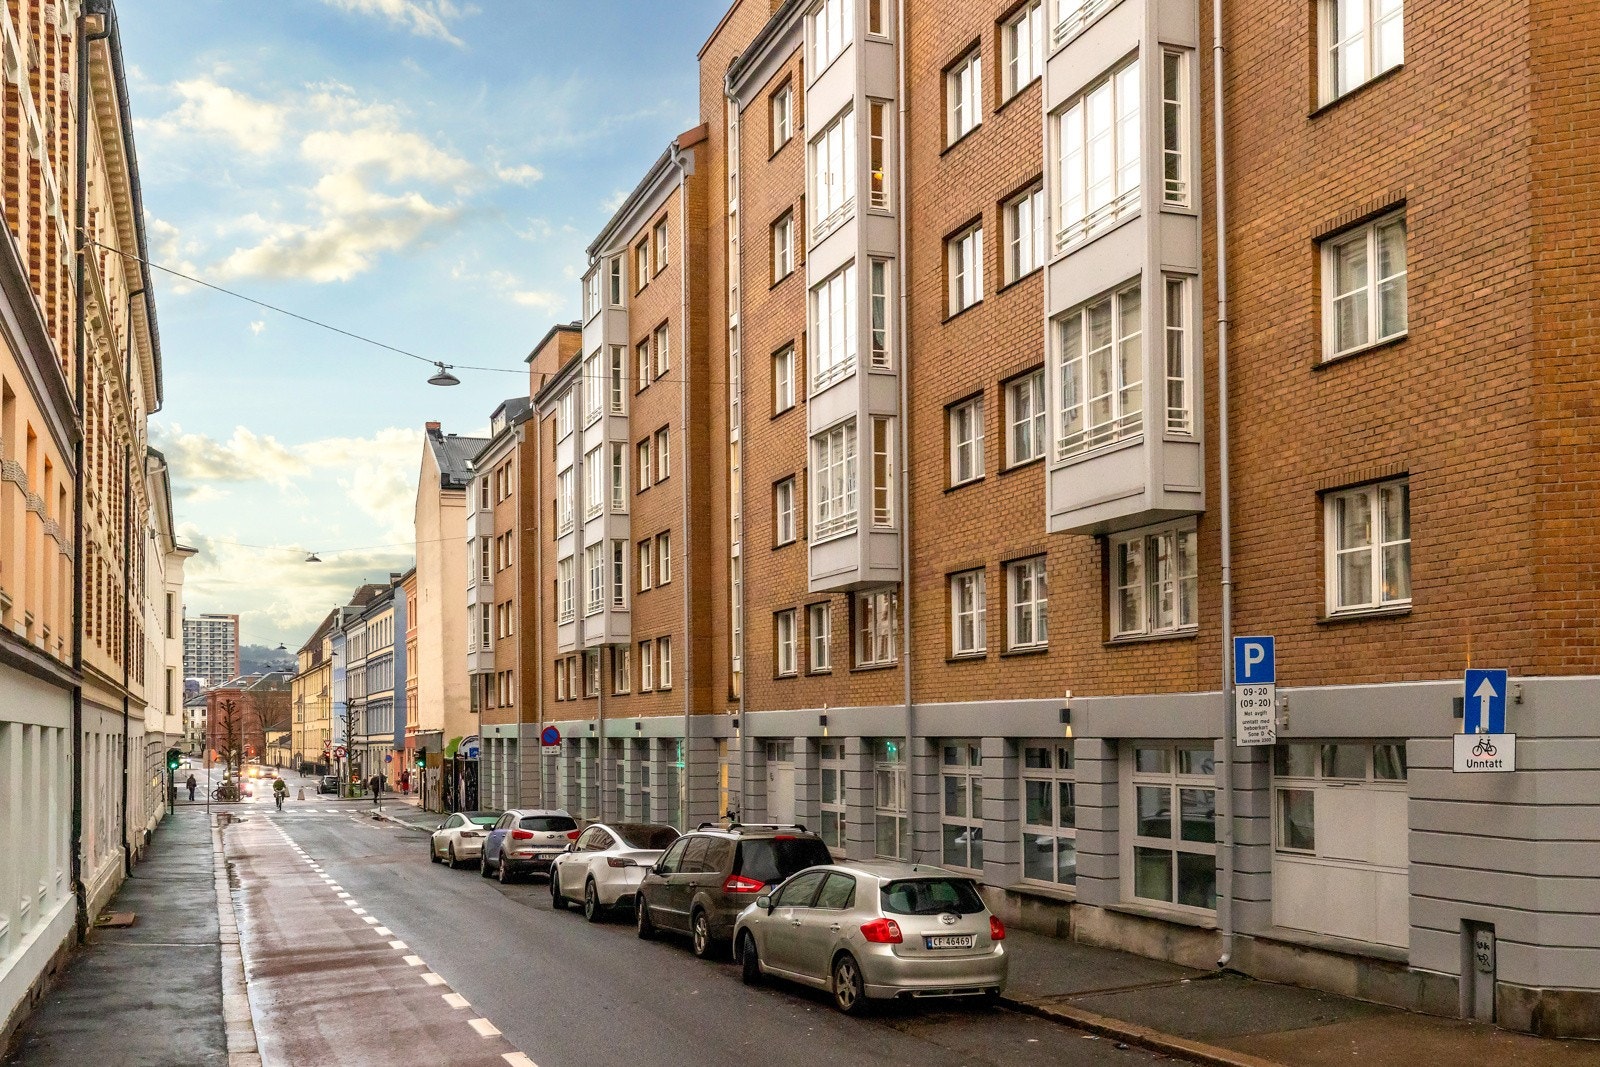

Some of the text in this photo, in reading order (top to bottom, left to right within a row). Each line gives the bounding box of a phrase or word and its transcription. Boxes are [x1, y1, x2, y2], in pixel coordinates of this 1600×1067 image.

[1244, 643, 1265, 678] P
[1466, 759, 1503, 768] Unntatt
[946, 936, 970, 945] 46469
